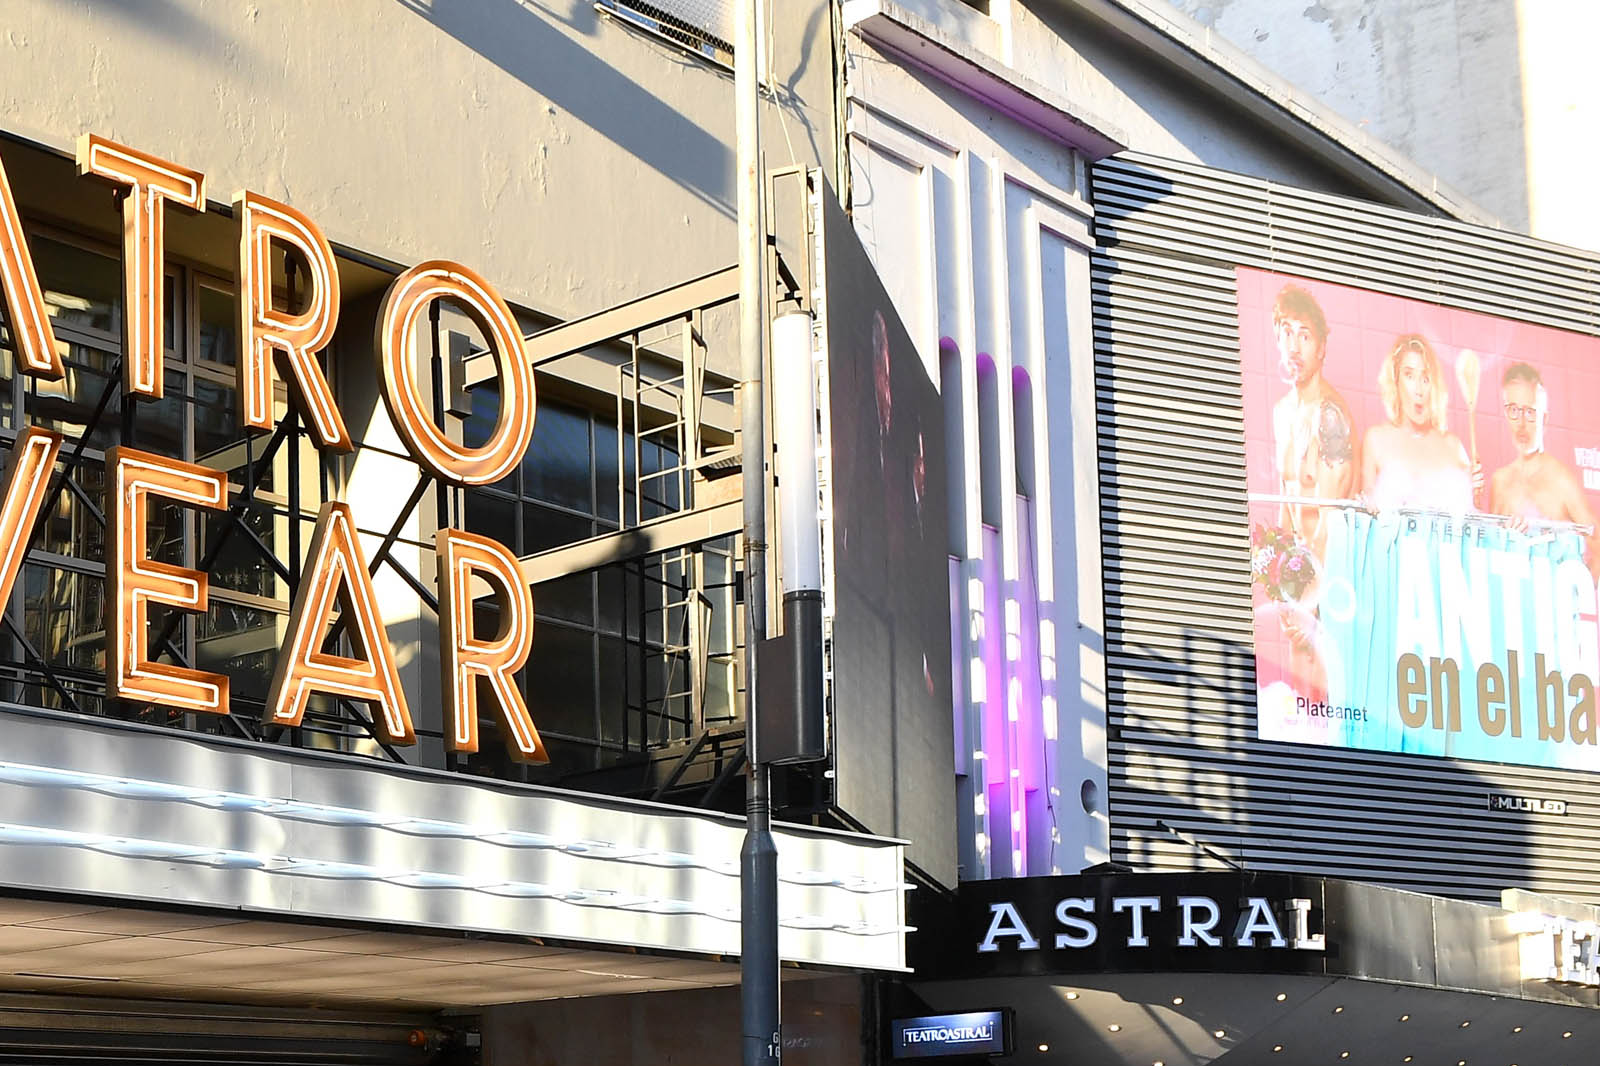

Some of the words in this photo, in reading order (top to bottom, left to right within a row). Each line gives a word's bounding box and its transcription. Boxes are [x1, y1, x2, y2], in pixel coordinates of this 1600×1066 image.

[1396, 537, 1600, 686] ANTIG
[1296, 696, 1368, 722] Plateanet
[1397, 652, 1462, 732] en
[1476, 649, 1522, 738] el
[1535, 653, 1598, 746] ba
[1498, 797, 1566, 814] MULTILED
[978, 896, 1325, 952] ASTRAL
